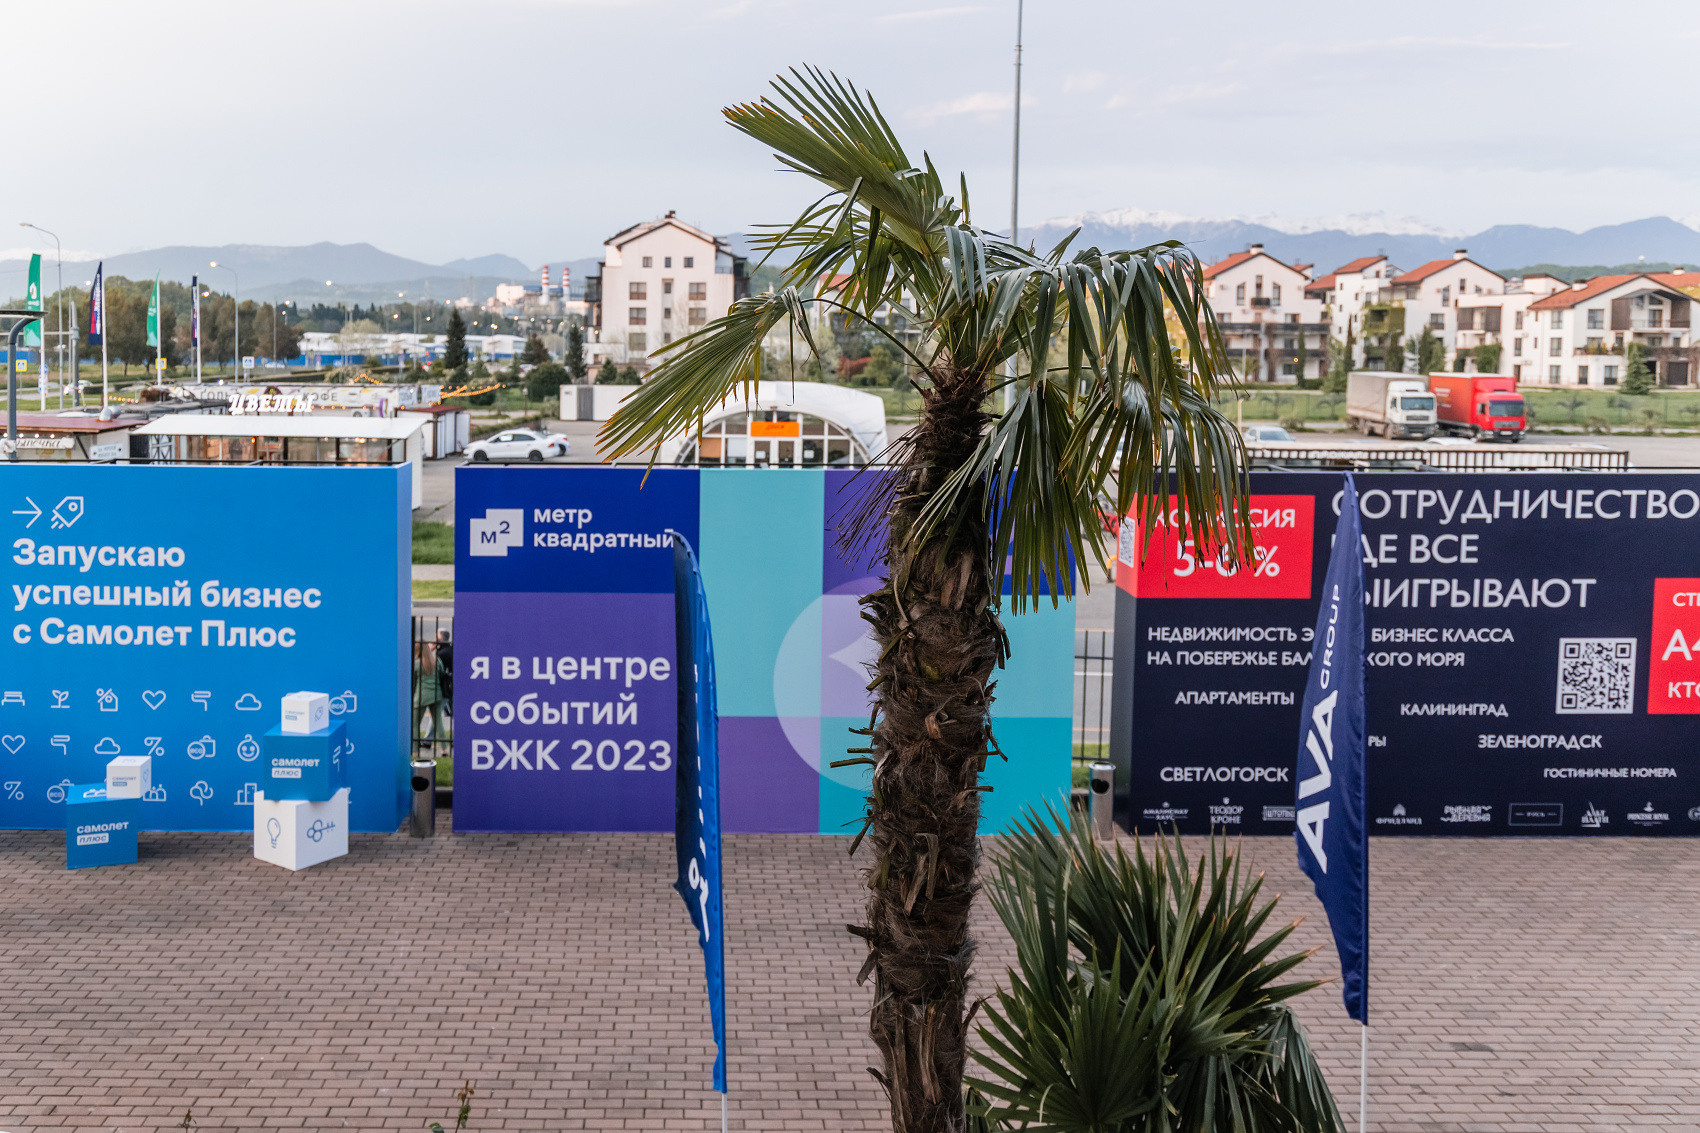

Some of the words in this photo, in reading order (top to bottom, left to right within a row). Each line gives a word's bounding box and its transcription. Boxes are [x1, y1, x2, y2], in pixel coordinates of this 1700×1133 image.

[533, 508, 593, 529] метр
[533, 528, 674, 554] квадратный
[1409, 534, 1480, 564] ВСЕ
[12, 538, 186, 573] Запускаю
[12, 580, 192, 612] успешный
[200, 580, 322, 609] бизнес
[12, 623, 32, 644] с
[40, 617, 192, 646] Самолет
[201, 619, 297, 648] Плюс
[1148, 627, 1298, 643] НЕДВИЖИМОСТЬ
[1371, 627, 1439, 643] БИЗНЕС
[1442, 627, 1515, 643] КЛАССА
[1147, 651, 1173, 666] НА
[1176, 651, 1278, 666] ПОБЕРЕЖЬЕ
[1416, 652, 1466, 666] МОРЯ
[470, 656, 490, 680] я
[502, 656, 522, 680] в
[532, 656, 671, 688] центре
[1174, 690, 1295, 705] АПАРТАМЕНТЫ
[470, 692, 638, 725] событий
[1400, 702, 1509, 718] КАЛИНИНГРАД
[1296, 689, 1338, 875] AVA
[1319, 584, 1341, 690] GROUP
[1478, 734, 1603, 750] ЗЕЛЕНОГРАДСК
[271, 758, 320, 768] самолет
[471, 739, 560, 771] ВЖК
[571, 739, 672, 772] 2023
[1159, 766, 1290, 783] СВЕТЛОГОРСК
[1543, 767, 1629, 779] ГОСТИНИЧНЫЕ
[1630, 767, 1678, 779] НОМЕРА
[76, 821, 129, 834] самолет
